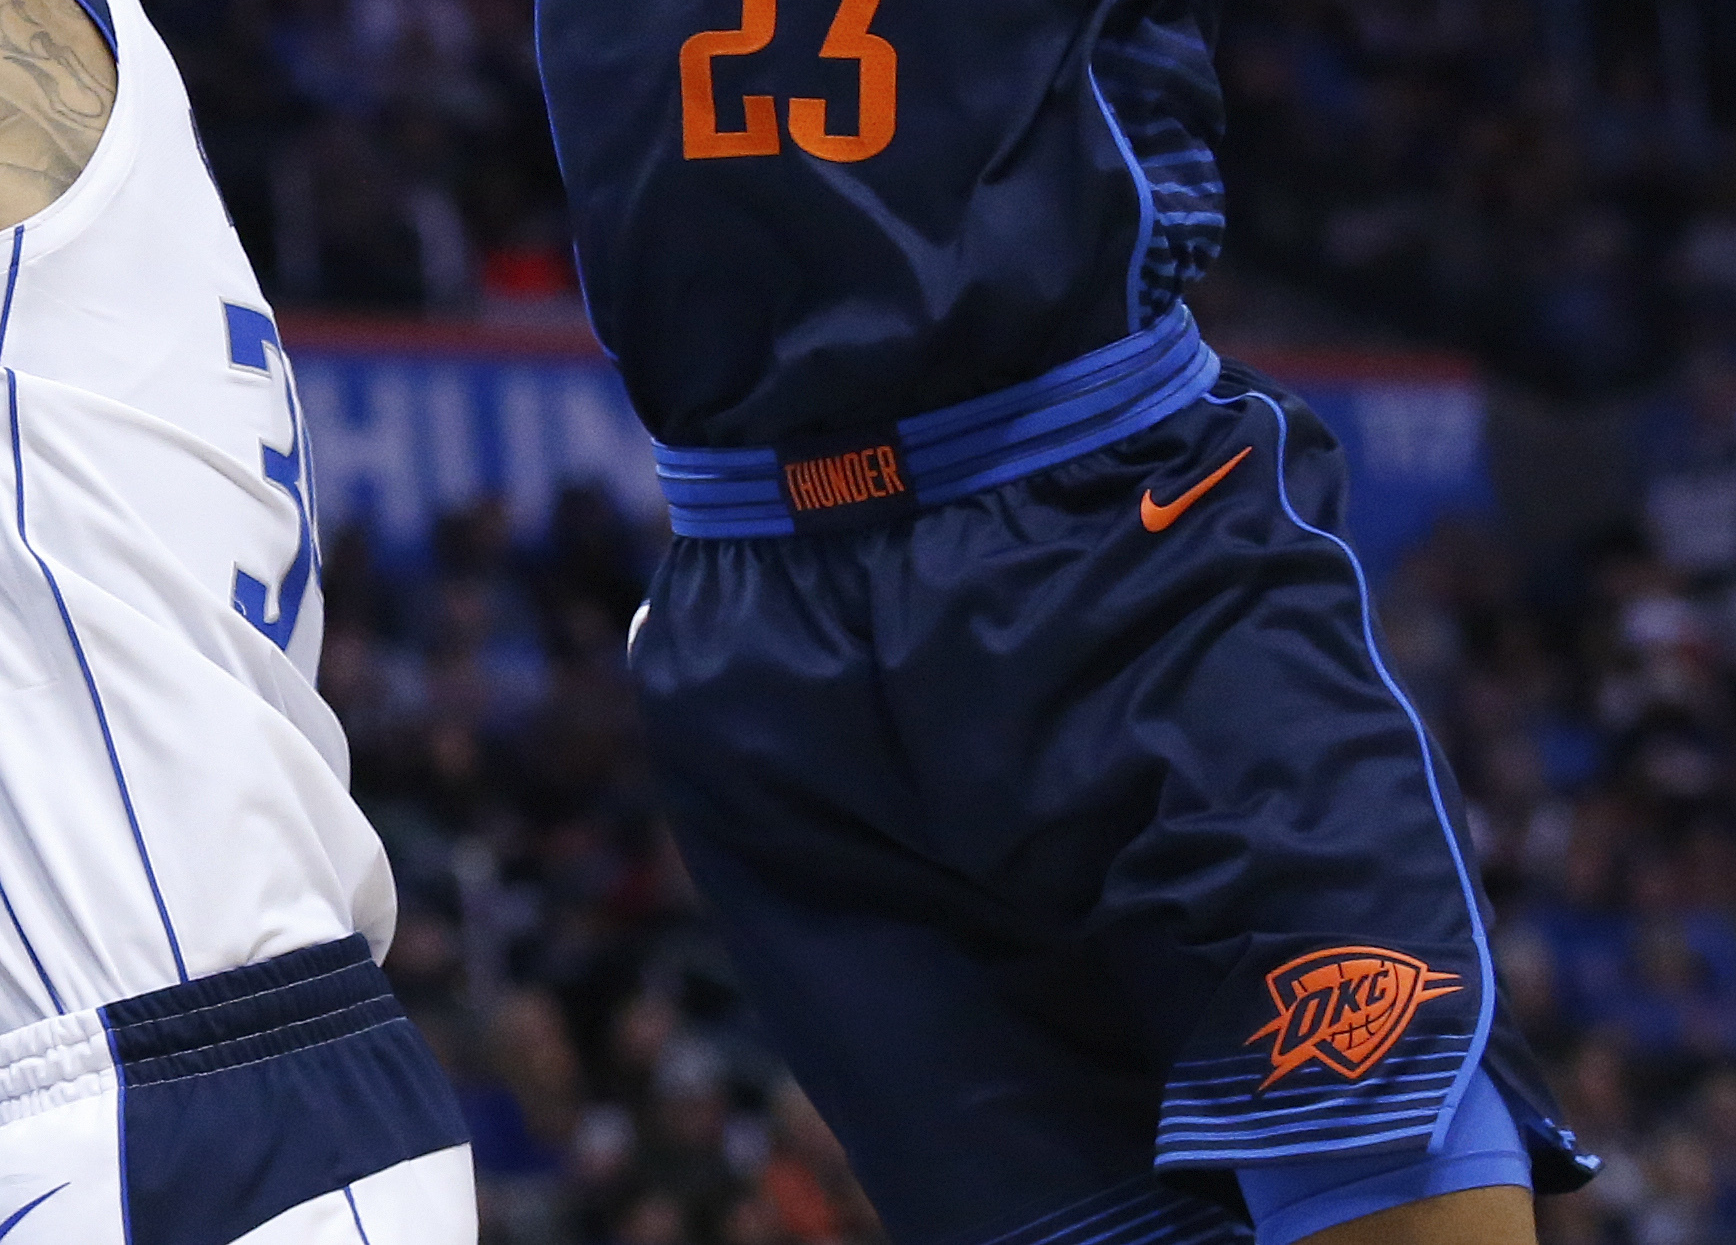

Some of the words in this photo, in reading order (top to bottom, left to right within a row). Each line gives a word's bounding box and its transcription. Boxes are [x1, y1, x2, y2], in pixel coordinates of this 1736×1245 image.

[219, 295, 320, 651] 3
[784, 445, 906, 511] THUNDER
[1276, 967, 1390, 1057] OKC
